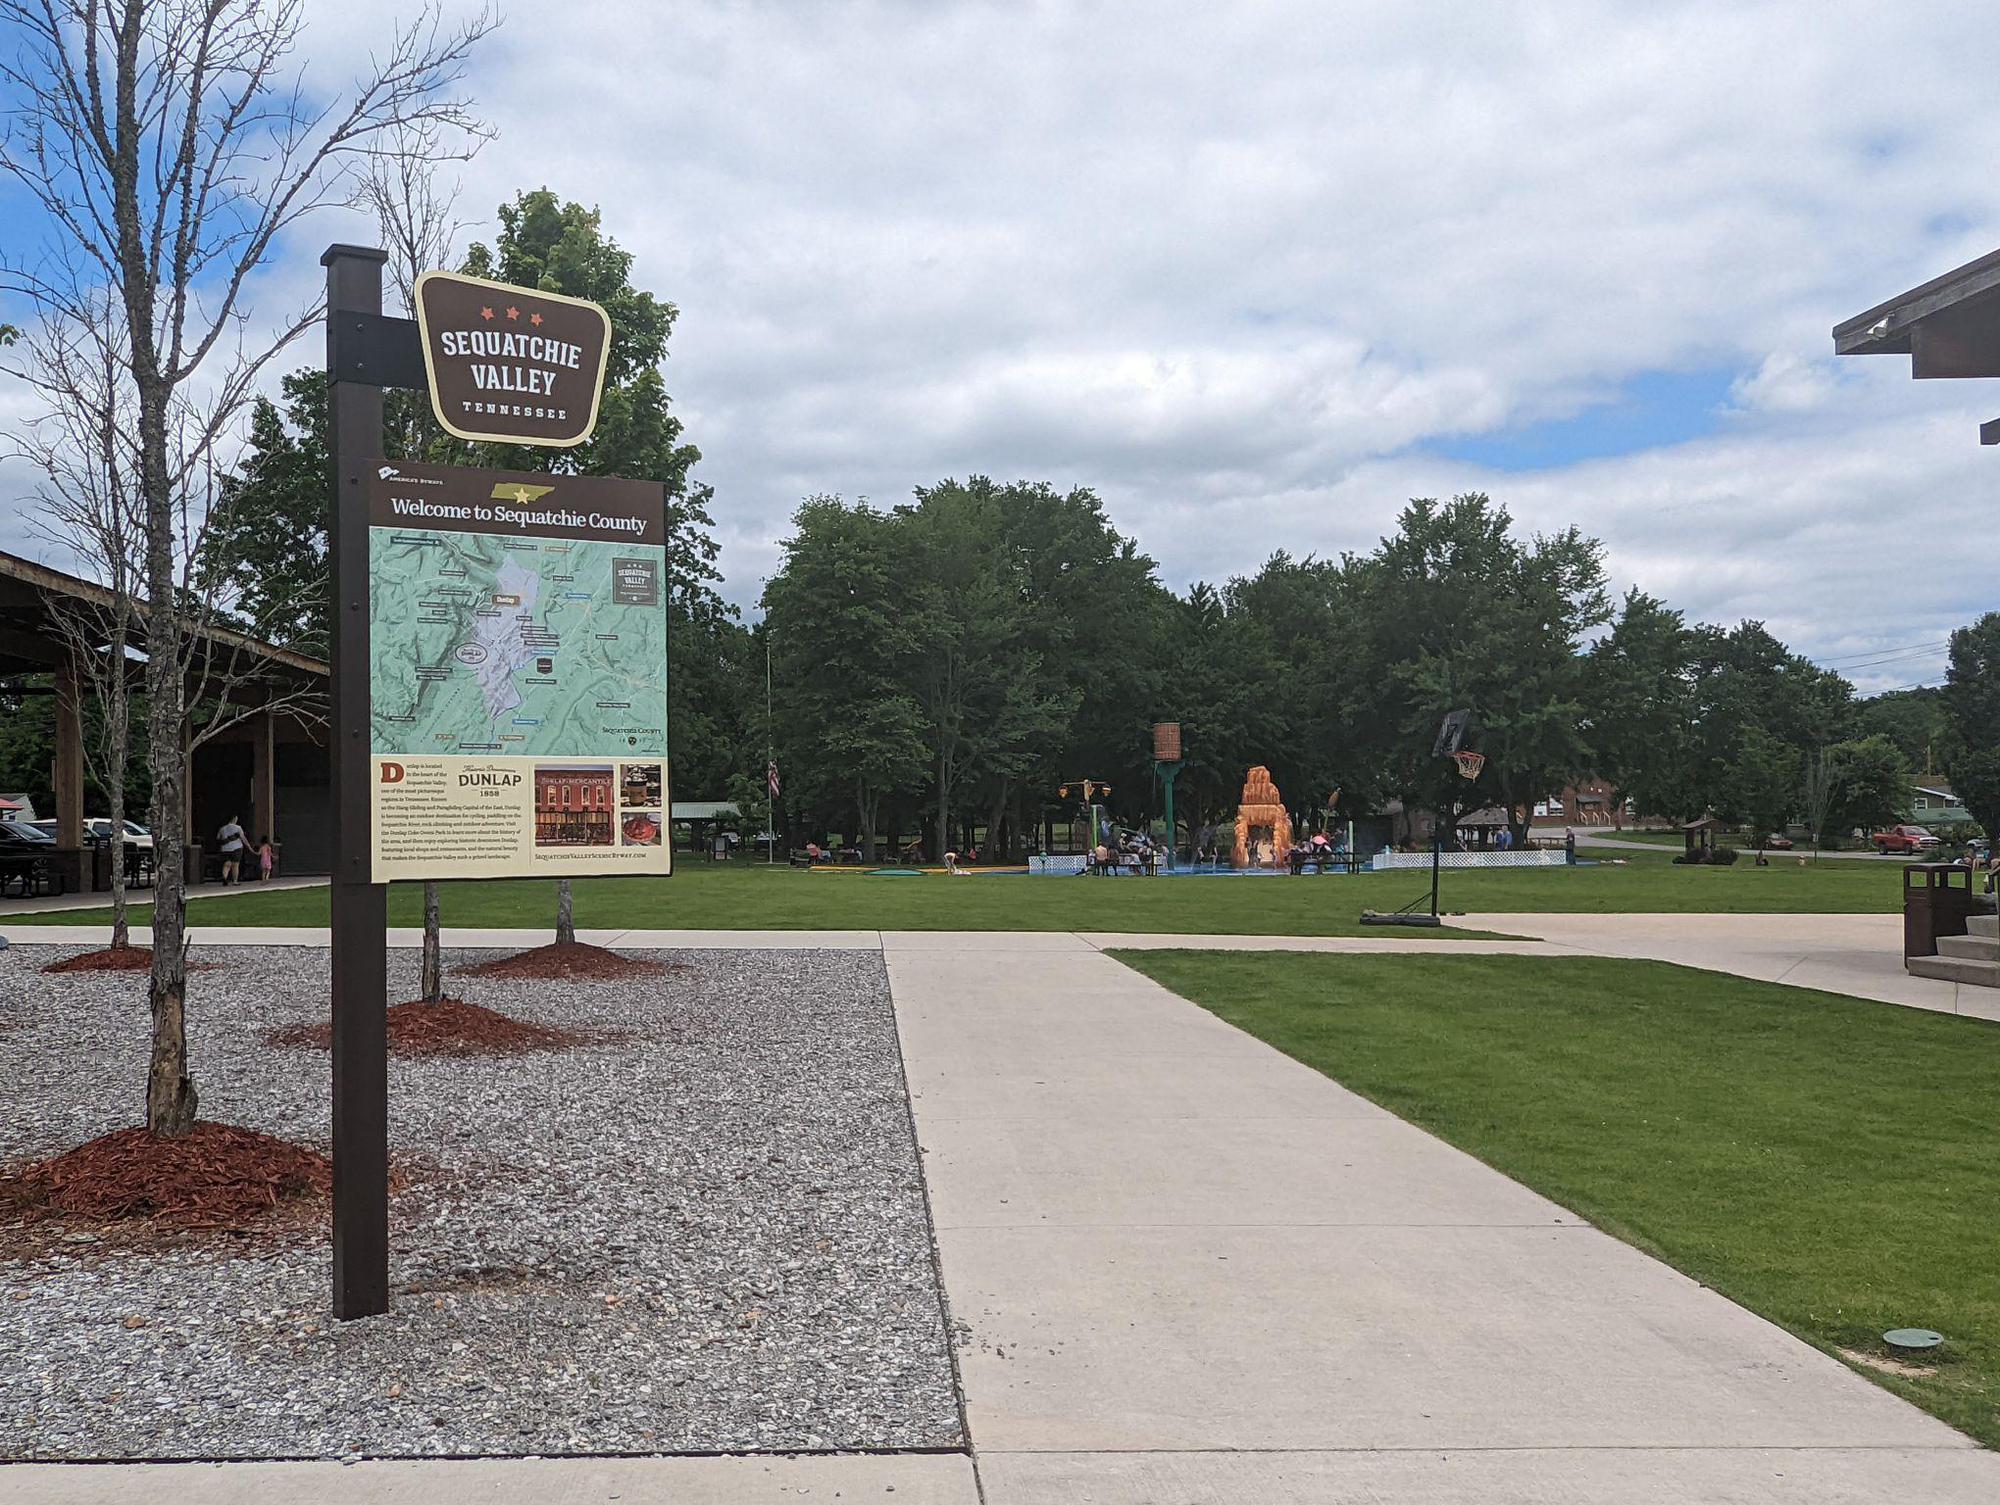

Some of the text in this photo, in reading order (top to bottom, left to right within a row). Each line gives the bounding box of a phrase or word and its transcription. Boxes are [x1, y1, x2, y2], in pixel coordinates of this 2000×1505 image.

[441, 330, 582, 370] SEQUATCHIE
[470, 364, 557, 396] VALLEY
[462, 401, 567, 420] TENNESSEE
[390, 498, 648, 534] Welcome to Sequatchie County
[458, 773, 522, 787] DUNLAP
